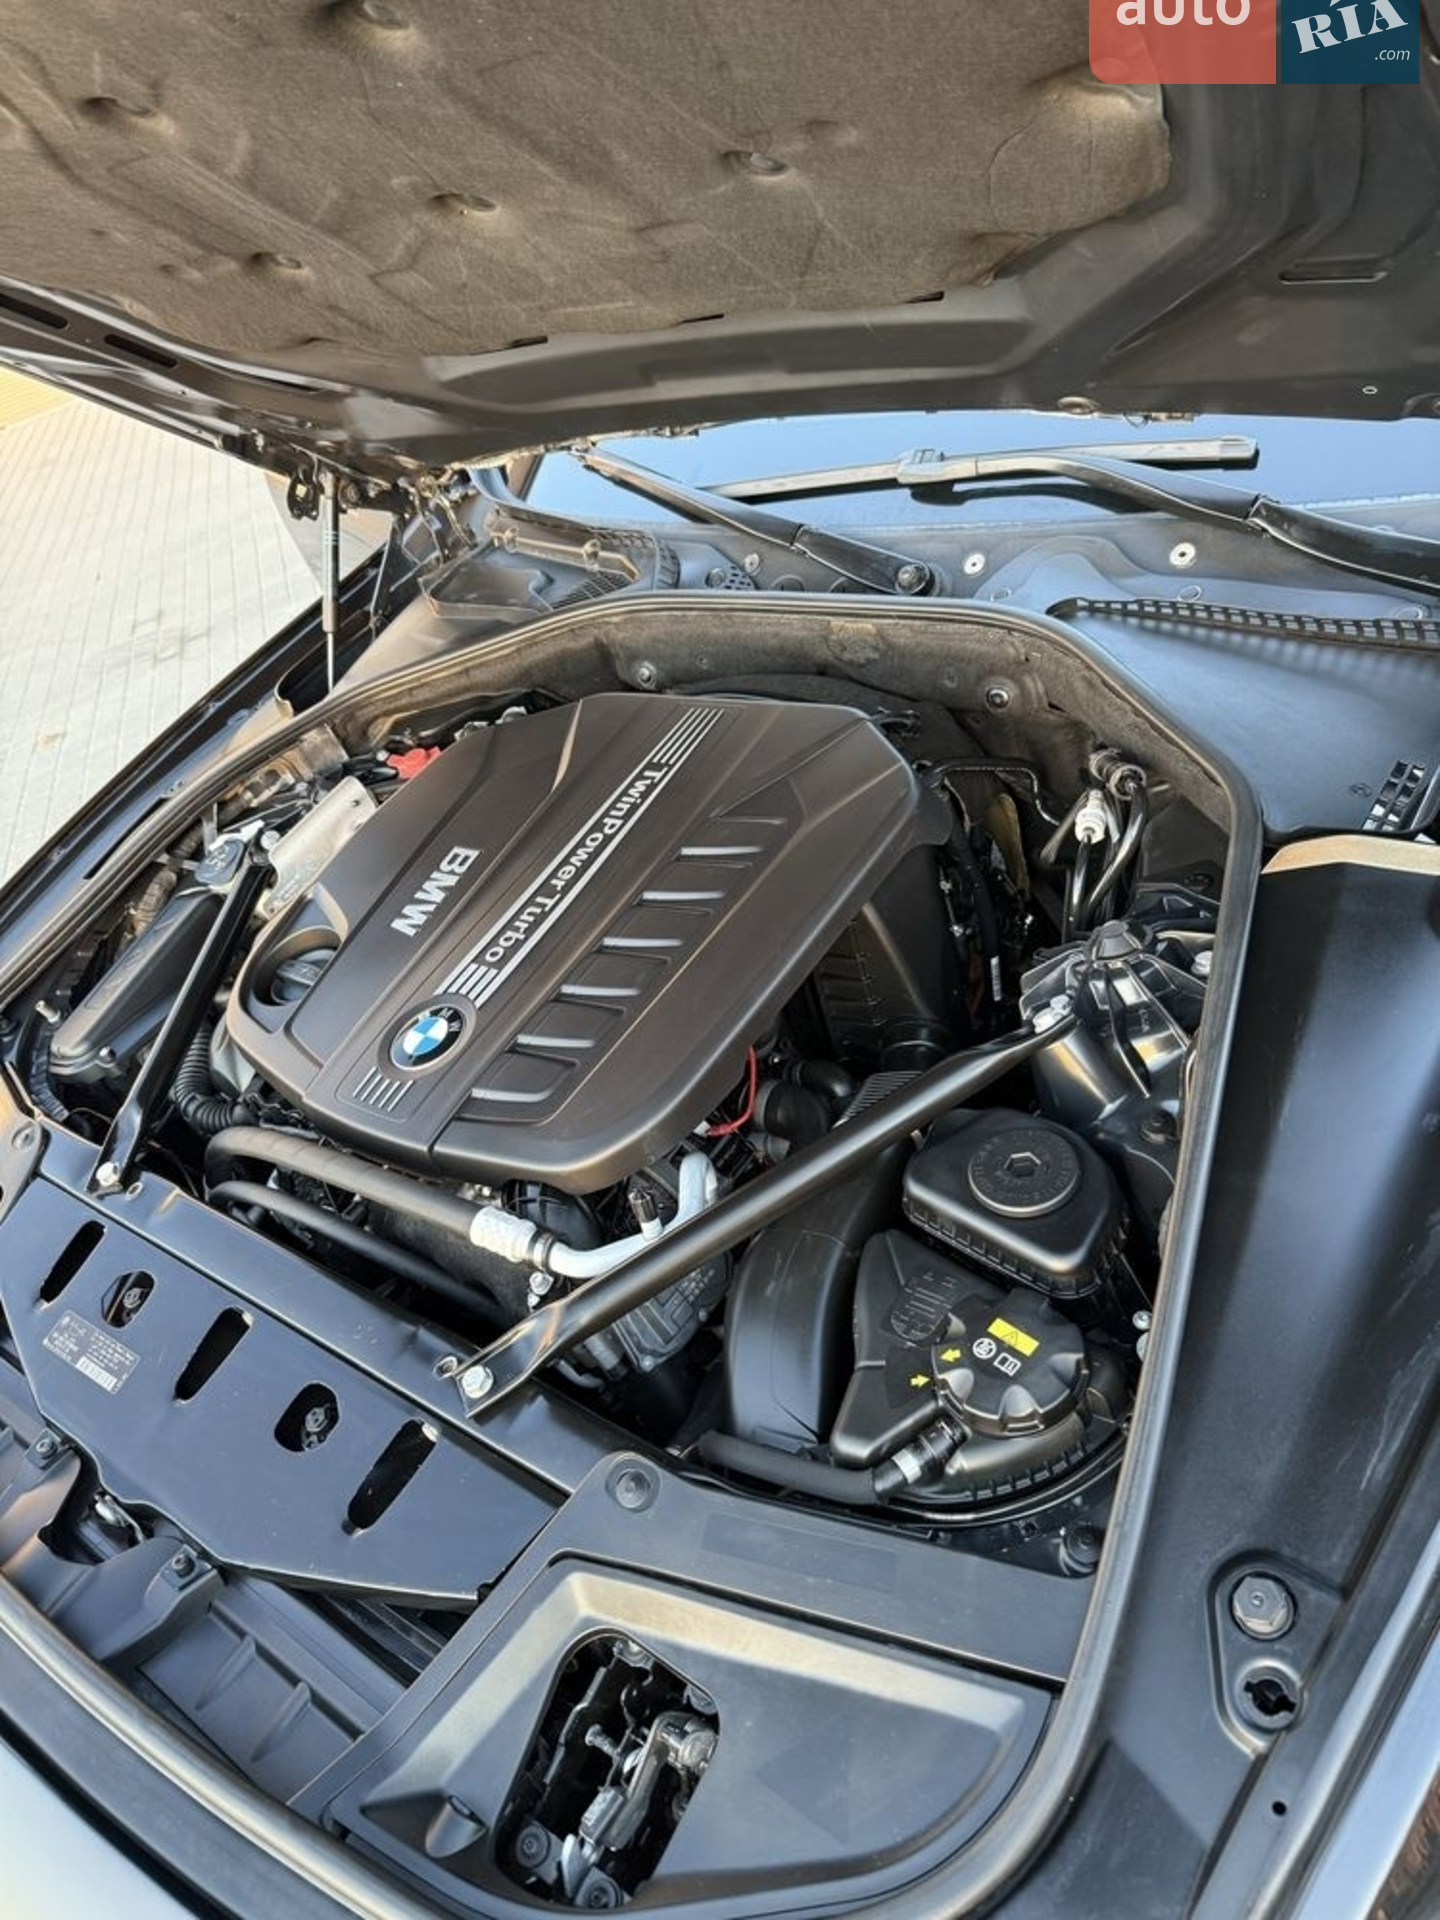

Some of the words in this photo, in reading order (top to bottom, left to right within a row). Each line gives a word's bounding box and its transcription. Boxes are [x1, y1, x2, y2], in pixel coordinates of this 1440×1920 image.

[550, 766, 669, 891] TwinPower
[390, 846, 480, 937] BMW
[485, 893, 561, 963] Turbo
